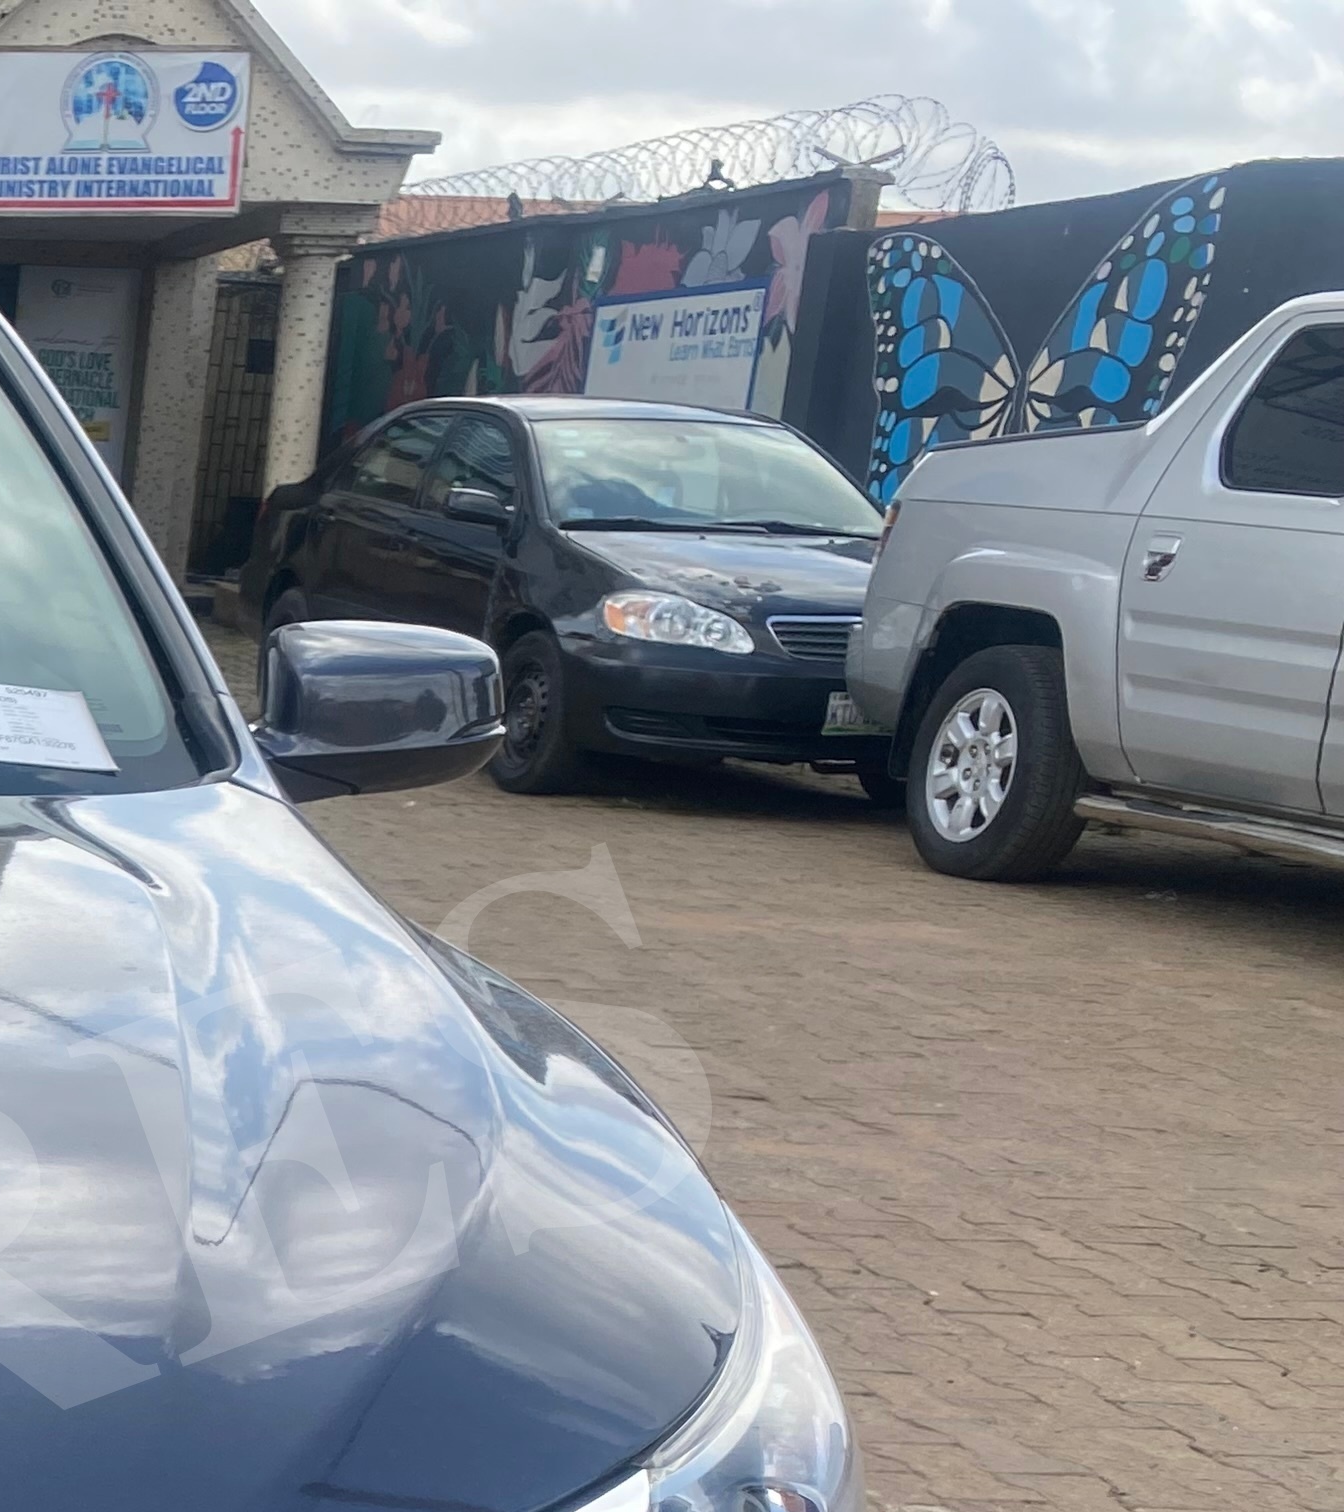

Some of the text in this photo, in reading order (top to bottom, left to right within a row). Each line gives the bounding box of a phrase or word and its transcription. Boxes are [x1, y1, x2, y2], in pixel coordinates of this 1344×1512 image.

[181, 81, 233, 102] 2ND
[184, 102, 229, 115] FLOOR
[45, 156, 102, 175] ALONE
[106, 155, 225, 175] EVANGELICAL
[75, 178, 216, 198] INTERNATIONAL
[627, 304, 752, 342] New Horizons
[668, 342, 700, 362] Learn
